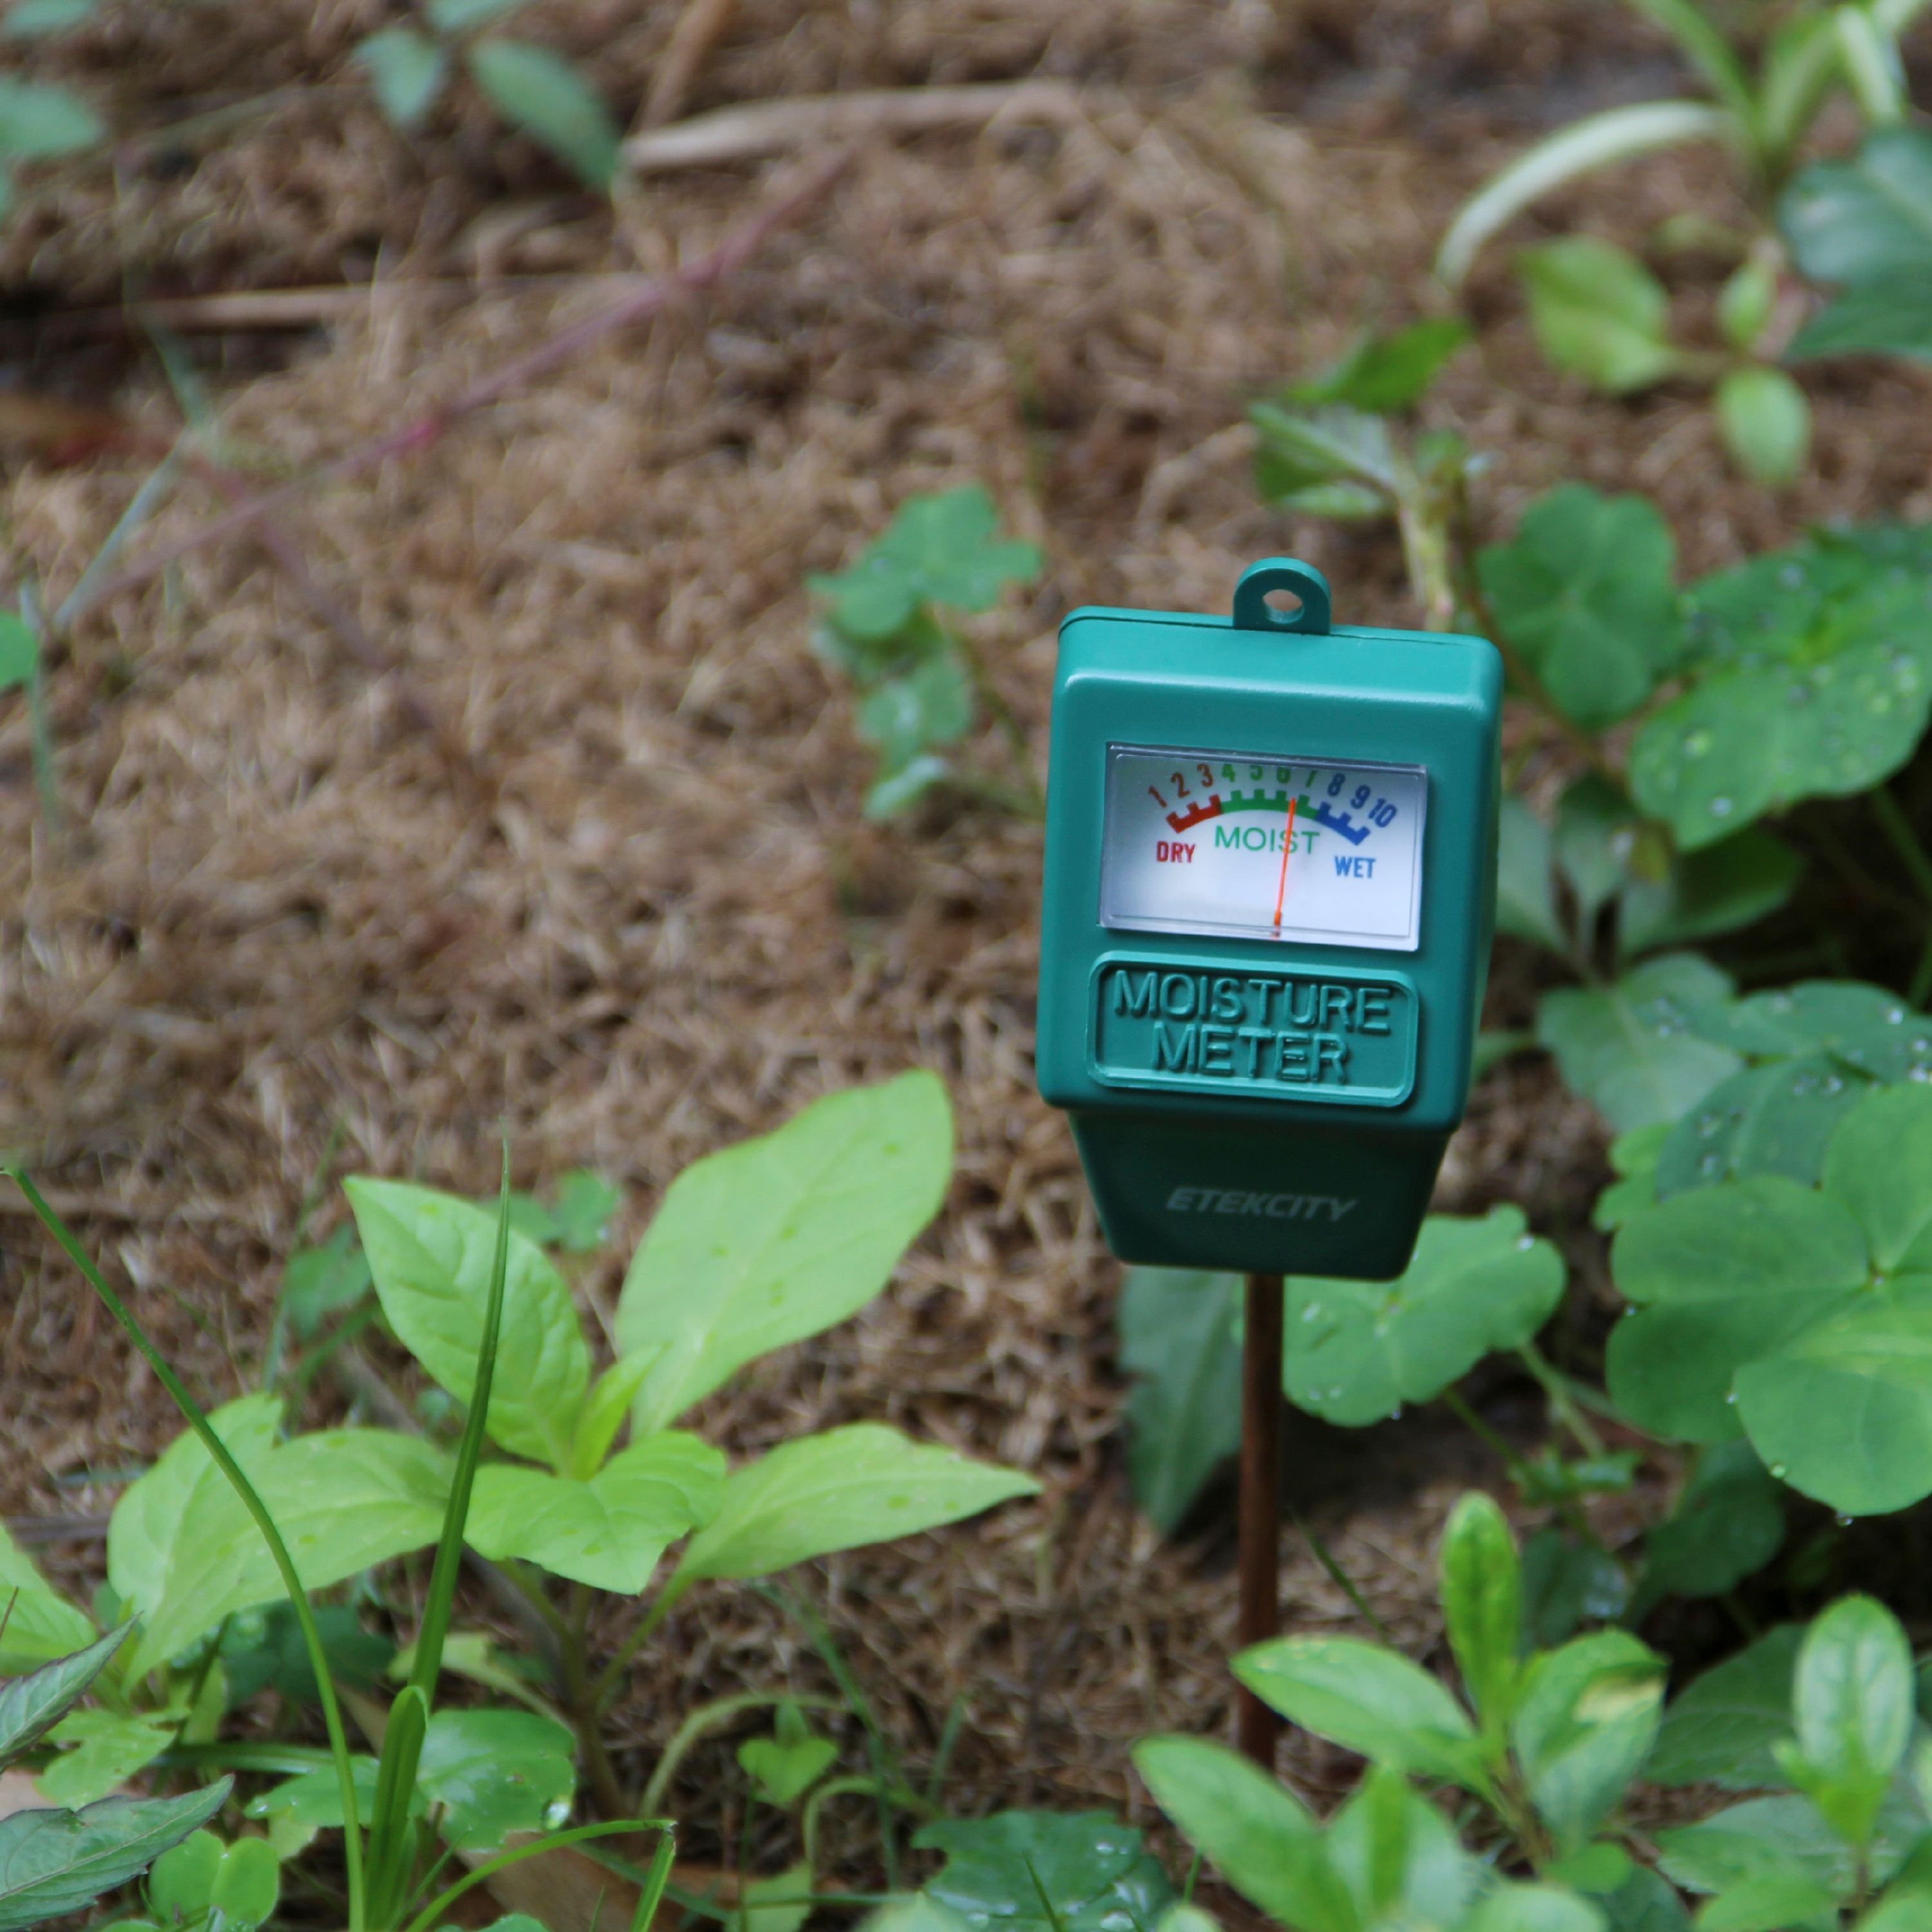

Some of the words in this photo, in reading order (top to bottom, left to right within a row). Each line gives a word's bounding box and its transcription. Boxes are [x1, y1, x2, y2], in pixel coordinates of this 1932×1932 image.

[1148, 786, 1168, 809] 1
[1171, 773, 1190, 798] 2
[1197, 764, 1214, 788] 3
[1221, 764, 1236, 783] 4
[1328, 773, 1345, 797] 8
[1351, 784, 1370, 810] 9
[1368, 798, 1397, 828] 10
[1157, 841, 1196, 863] DRY
[1215, 825, 1320, 855] MOIST
[1334, 856, 1376, 878] WET
[1113, 970, 1392, 1035] MOISTURE
[1151, 1021, 1348, 1083] METER
[1166, 1187, 1358, 1222] ETEKCITY
